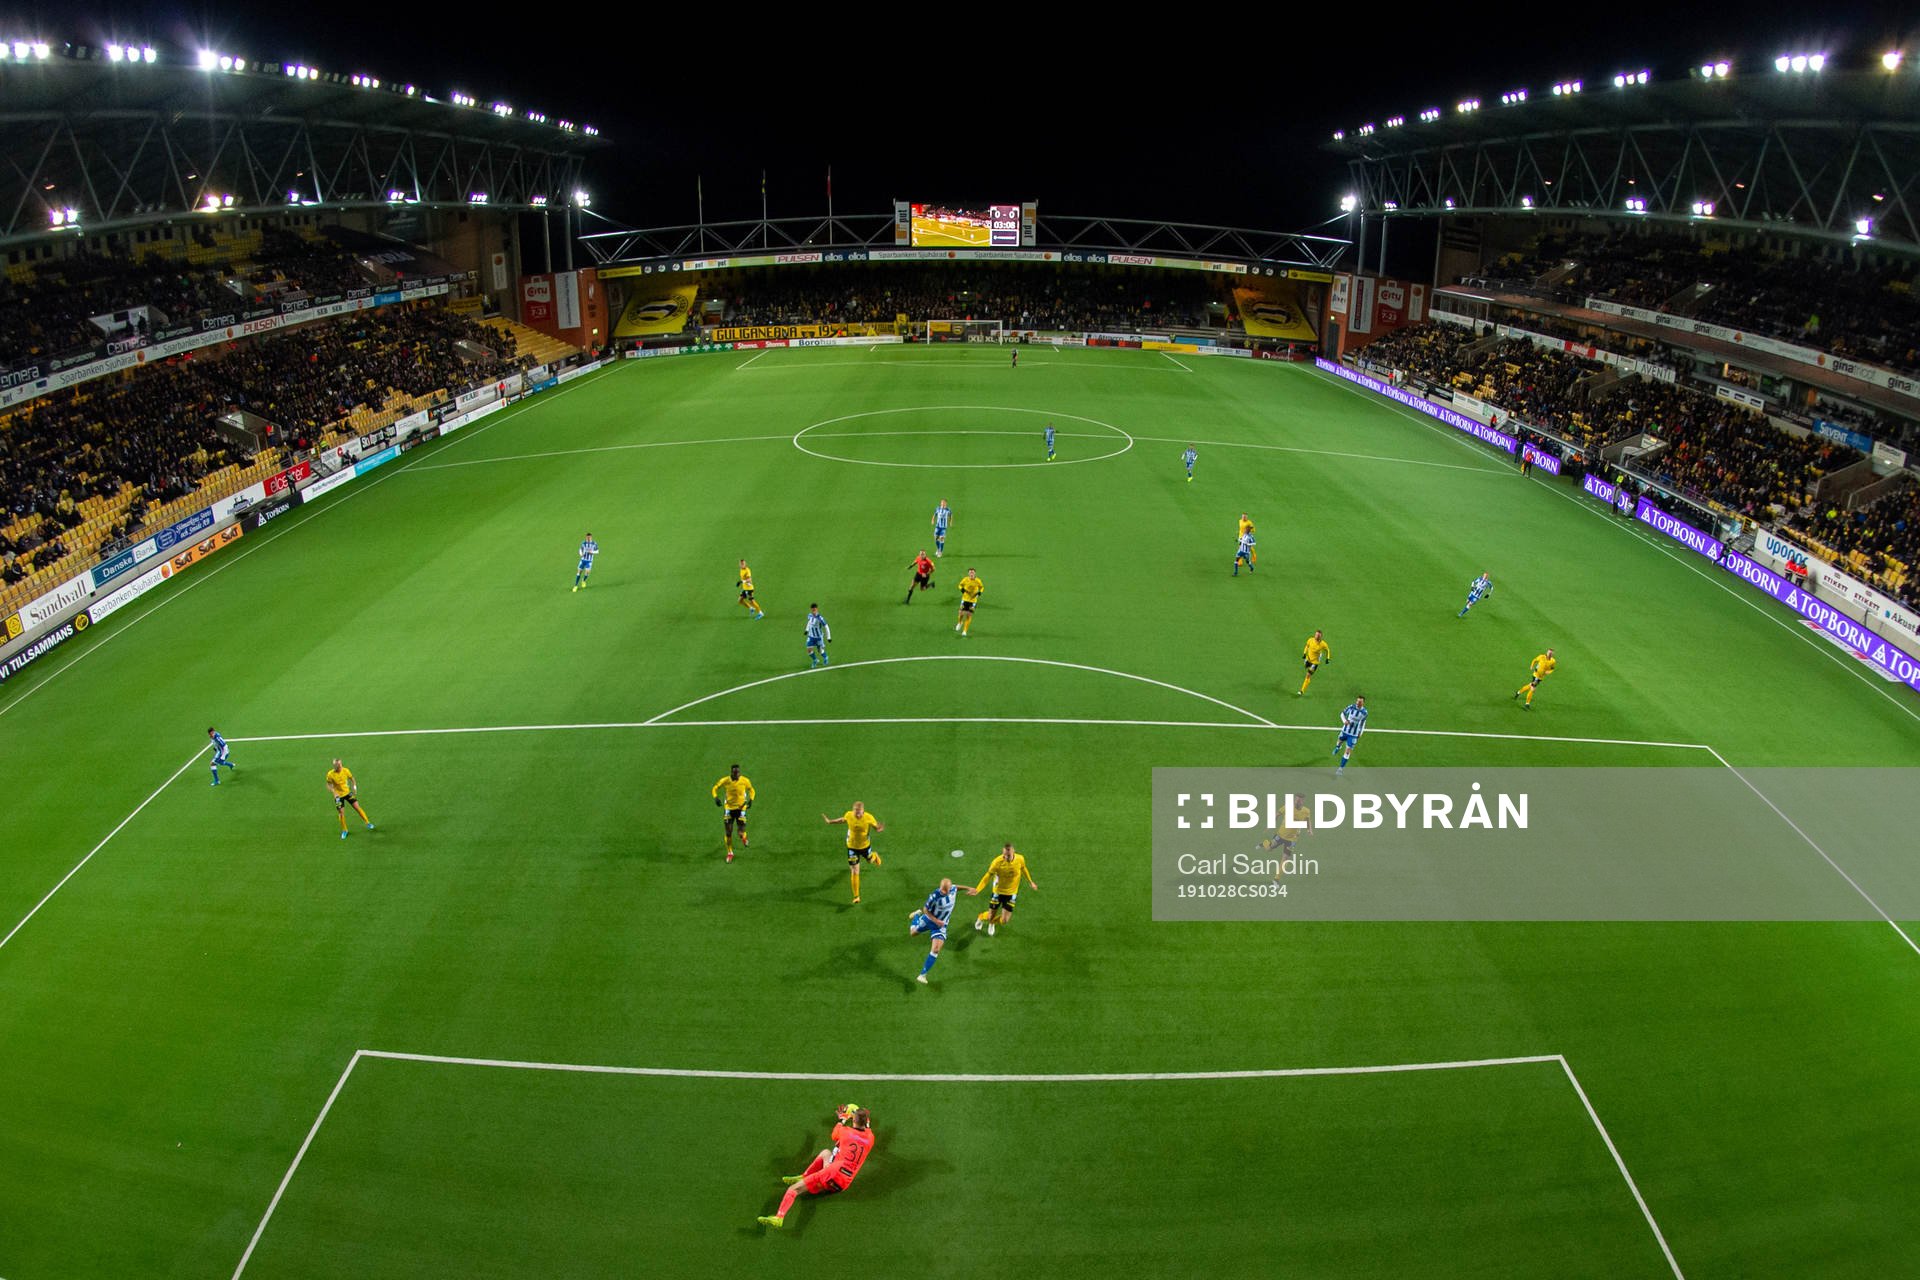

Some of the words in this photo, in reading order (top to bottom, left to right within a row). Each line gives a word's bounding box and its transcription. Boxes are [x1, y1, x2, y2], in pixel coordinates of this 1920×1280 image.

[994, 221, 1016, 229] 03:08
[778, 255, 820, 263] PULSEN
[1111, 256, 1153, 265] PULSEN
[243, 318, 277, 335] PULSEN
[985, 335, 1020, 344] XL-YGG
[0, 365, 40, 388] ernera
[1832, 356, 1854, 374] gina
[1888, 375, 1912, 392] gina
[1413, 394, 1438, 416] TOPBORN
[1445, 409, 1473, 435] TOPBORN
[1480, 425, 1512, 451] TOPBORN
[1651, 510, 1706, 551] TOPBORN
[102, 556, 133, 579] Danske
[135, 543, 155, 561] Bank
[29, 580, 88, 627] Sandwall
[92, 588, 133, 620] Sparbanken
[1801, 593, 1872, 653] TOPBORN
[1890, 612, 1917, 633] Akust
[10, 623, 74, 671] TILLSAMMANS
[845, 1143, 865, 1166] 31
